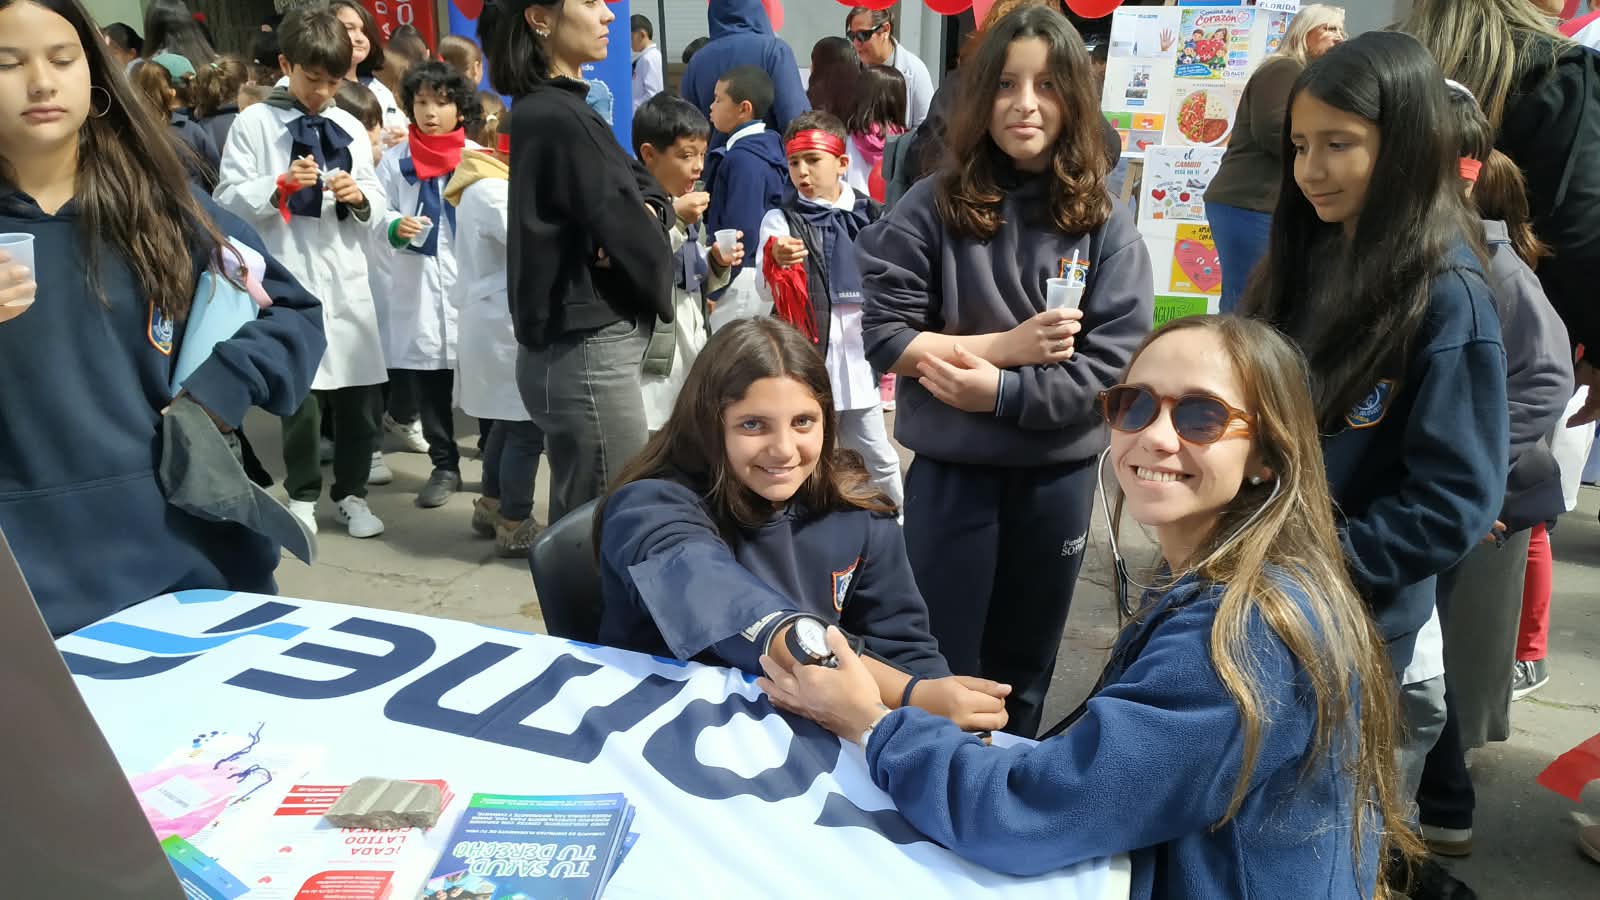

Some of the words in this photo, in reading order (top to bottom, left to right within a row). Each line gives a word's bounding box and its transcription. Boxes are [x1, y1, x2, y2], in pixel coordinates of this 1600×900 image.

[1259, 2, 1297, 11] FLORIDA
[1195, 14, 1237, 26] Corazón
[1184, 148, 1194, 160] el
[344, 835, 407, 844] LATIDO
[452, 840, 557, 861] DERECHO
[556, 843, 597, 861] TU
[465, 857, 549, 878] SALUD,
[549, 860, 590, 878] TU
